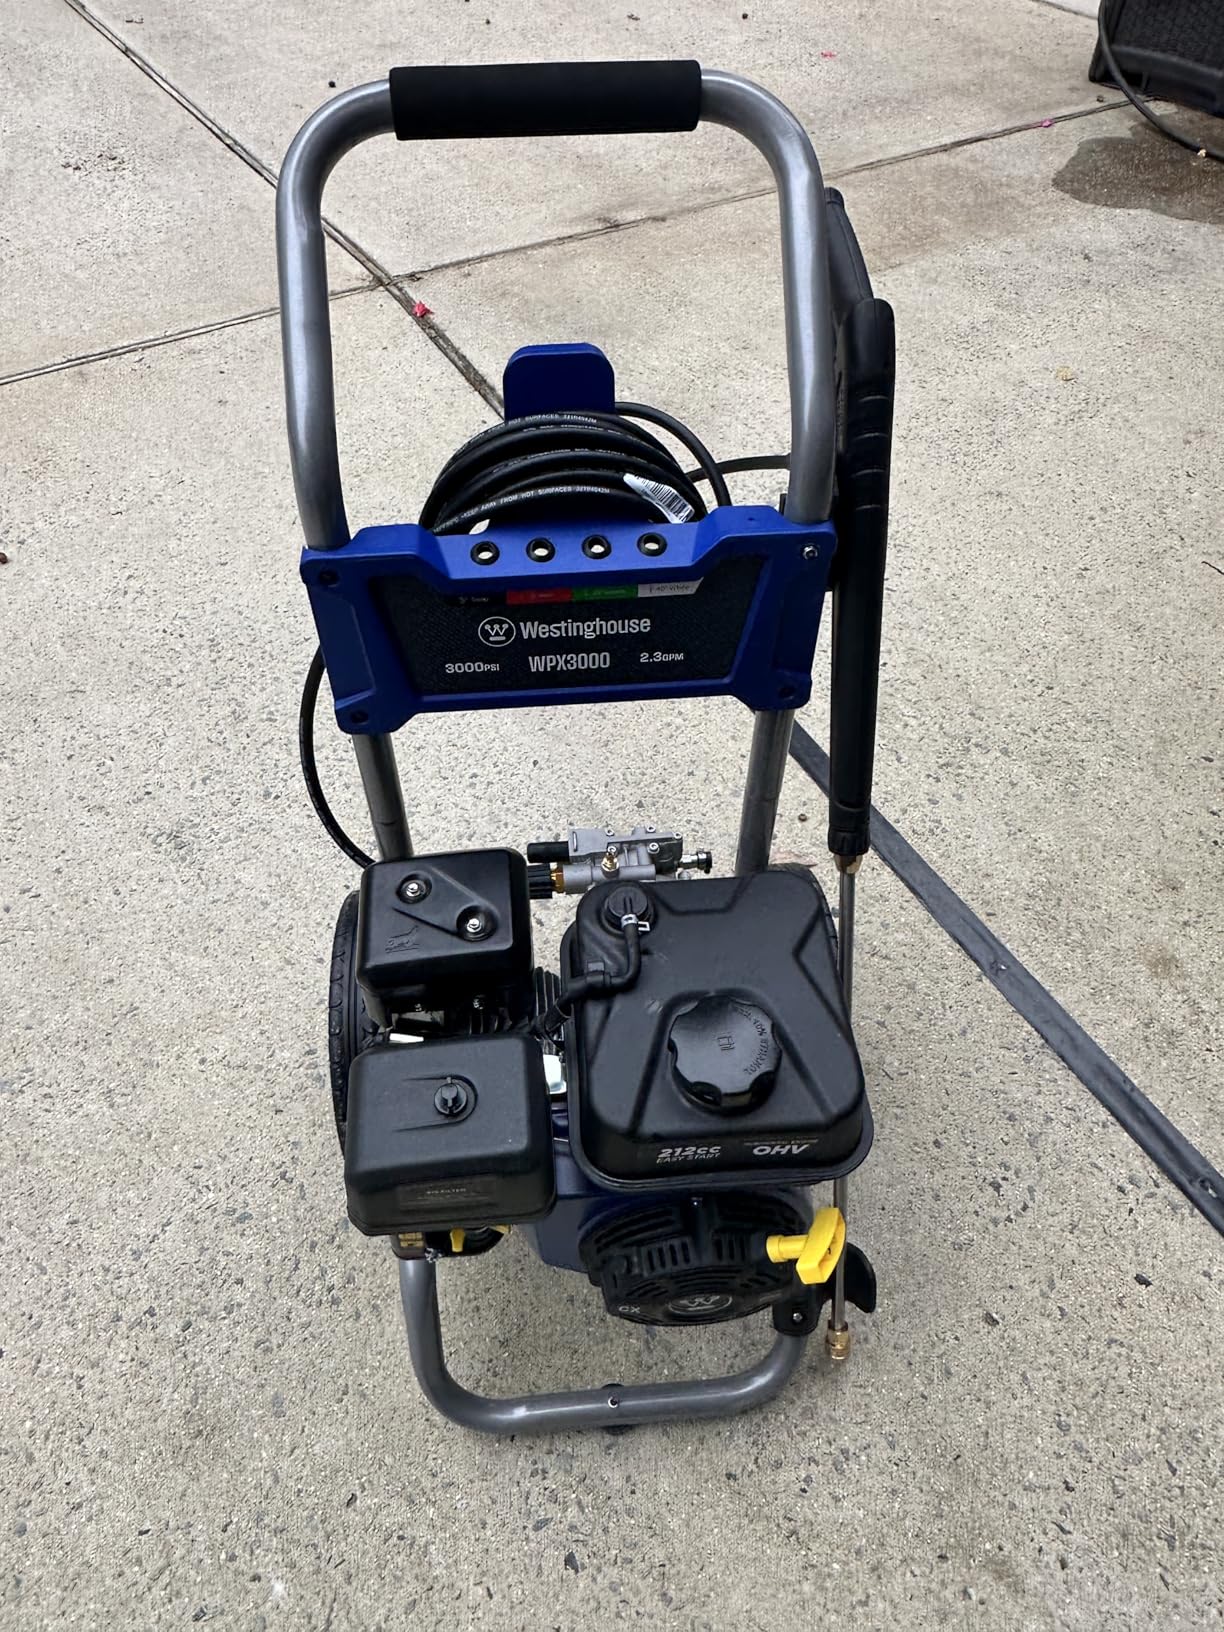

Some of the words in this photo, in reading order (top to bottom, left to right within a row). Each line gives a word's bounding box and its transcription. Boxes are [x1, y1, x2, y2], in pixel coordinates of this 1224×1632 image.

[500, 494, 518, 504] FROM
[519, 617, 651, 639] Westinghouse
[528, 652, 611, 672] WPX3000
[752, 1143, 810, 1156] OHV
